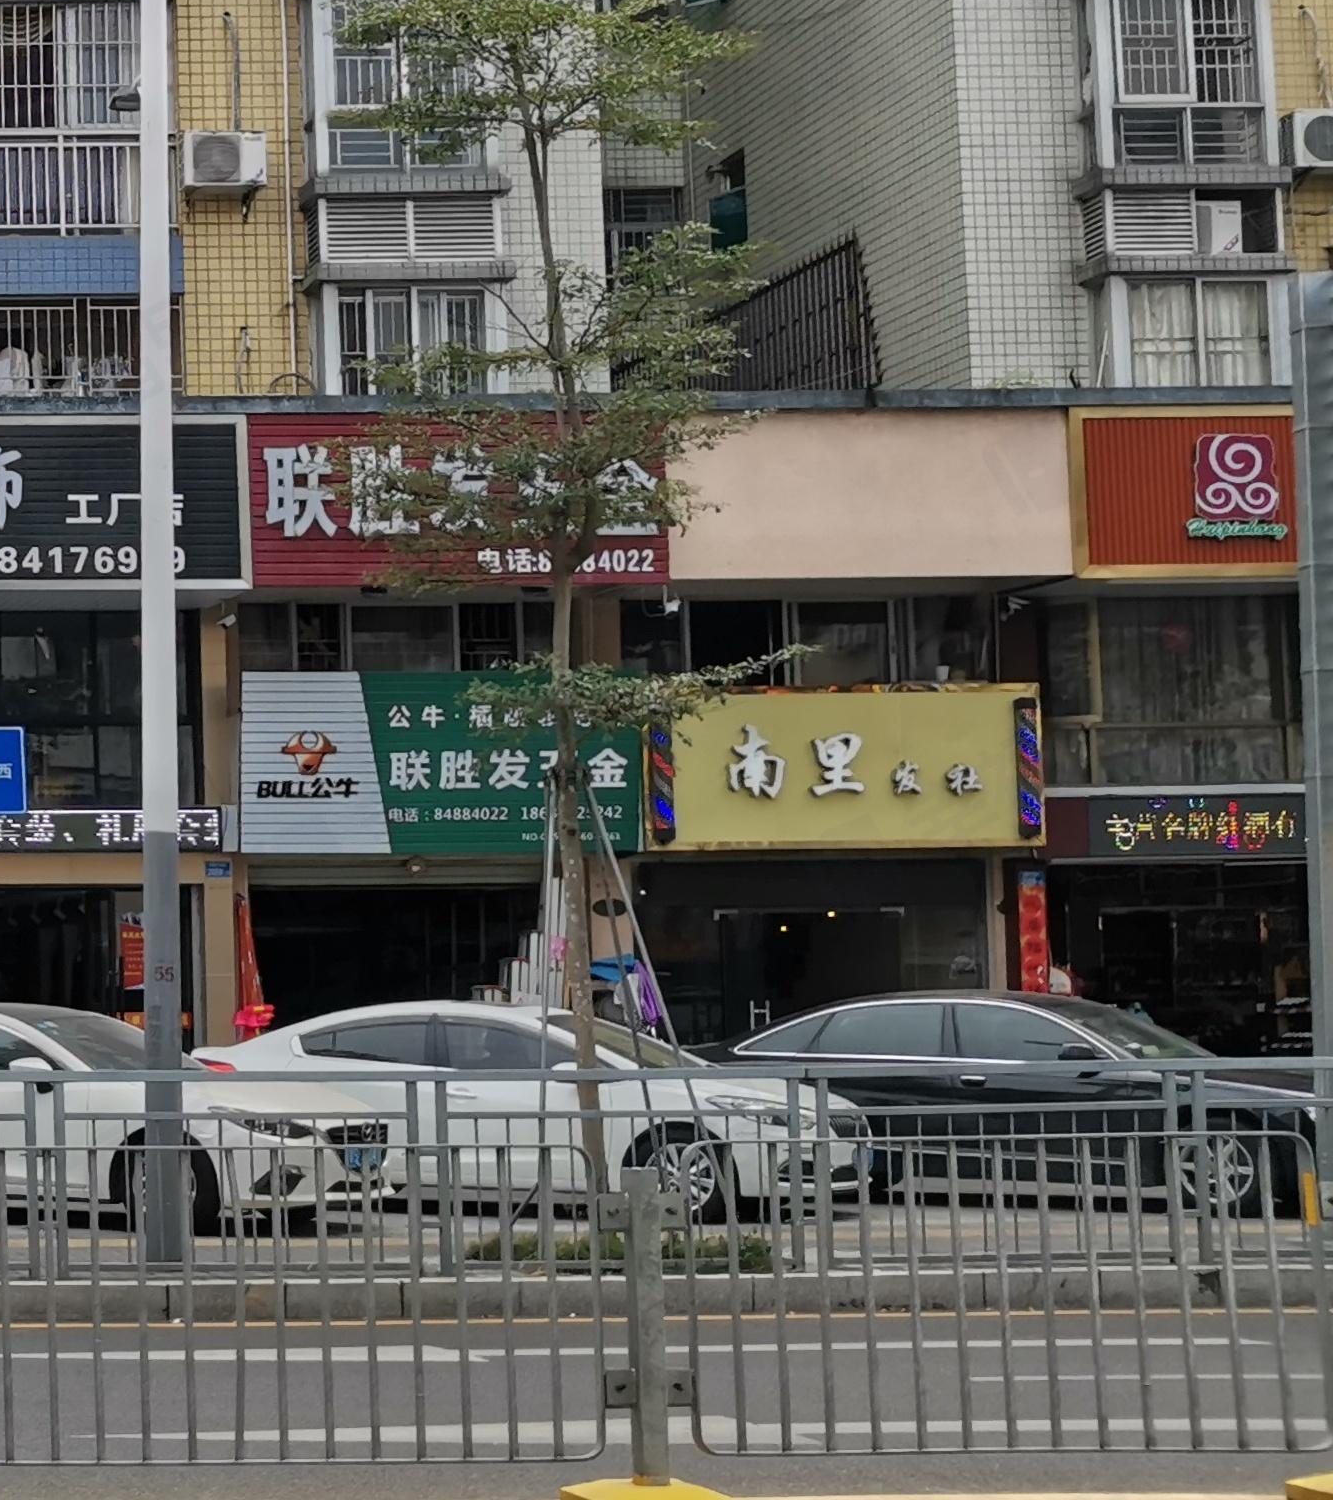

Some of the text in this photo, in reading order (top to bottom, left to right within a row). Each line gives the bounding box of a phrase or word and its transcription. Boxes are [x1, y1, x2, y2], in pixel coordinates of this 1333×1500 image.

[262, 443, 659, 538] 联胜金
[477, 547, 655, 574] 电话:884022
[257, 777, 360, 800] BULL公牛
[520, 805, 623, 821] 1862242
